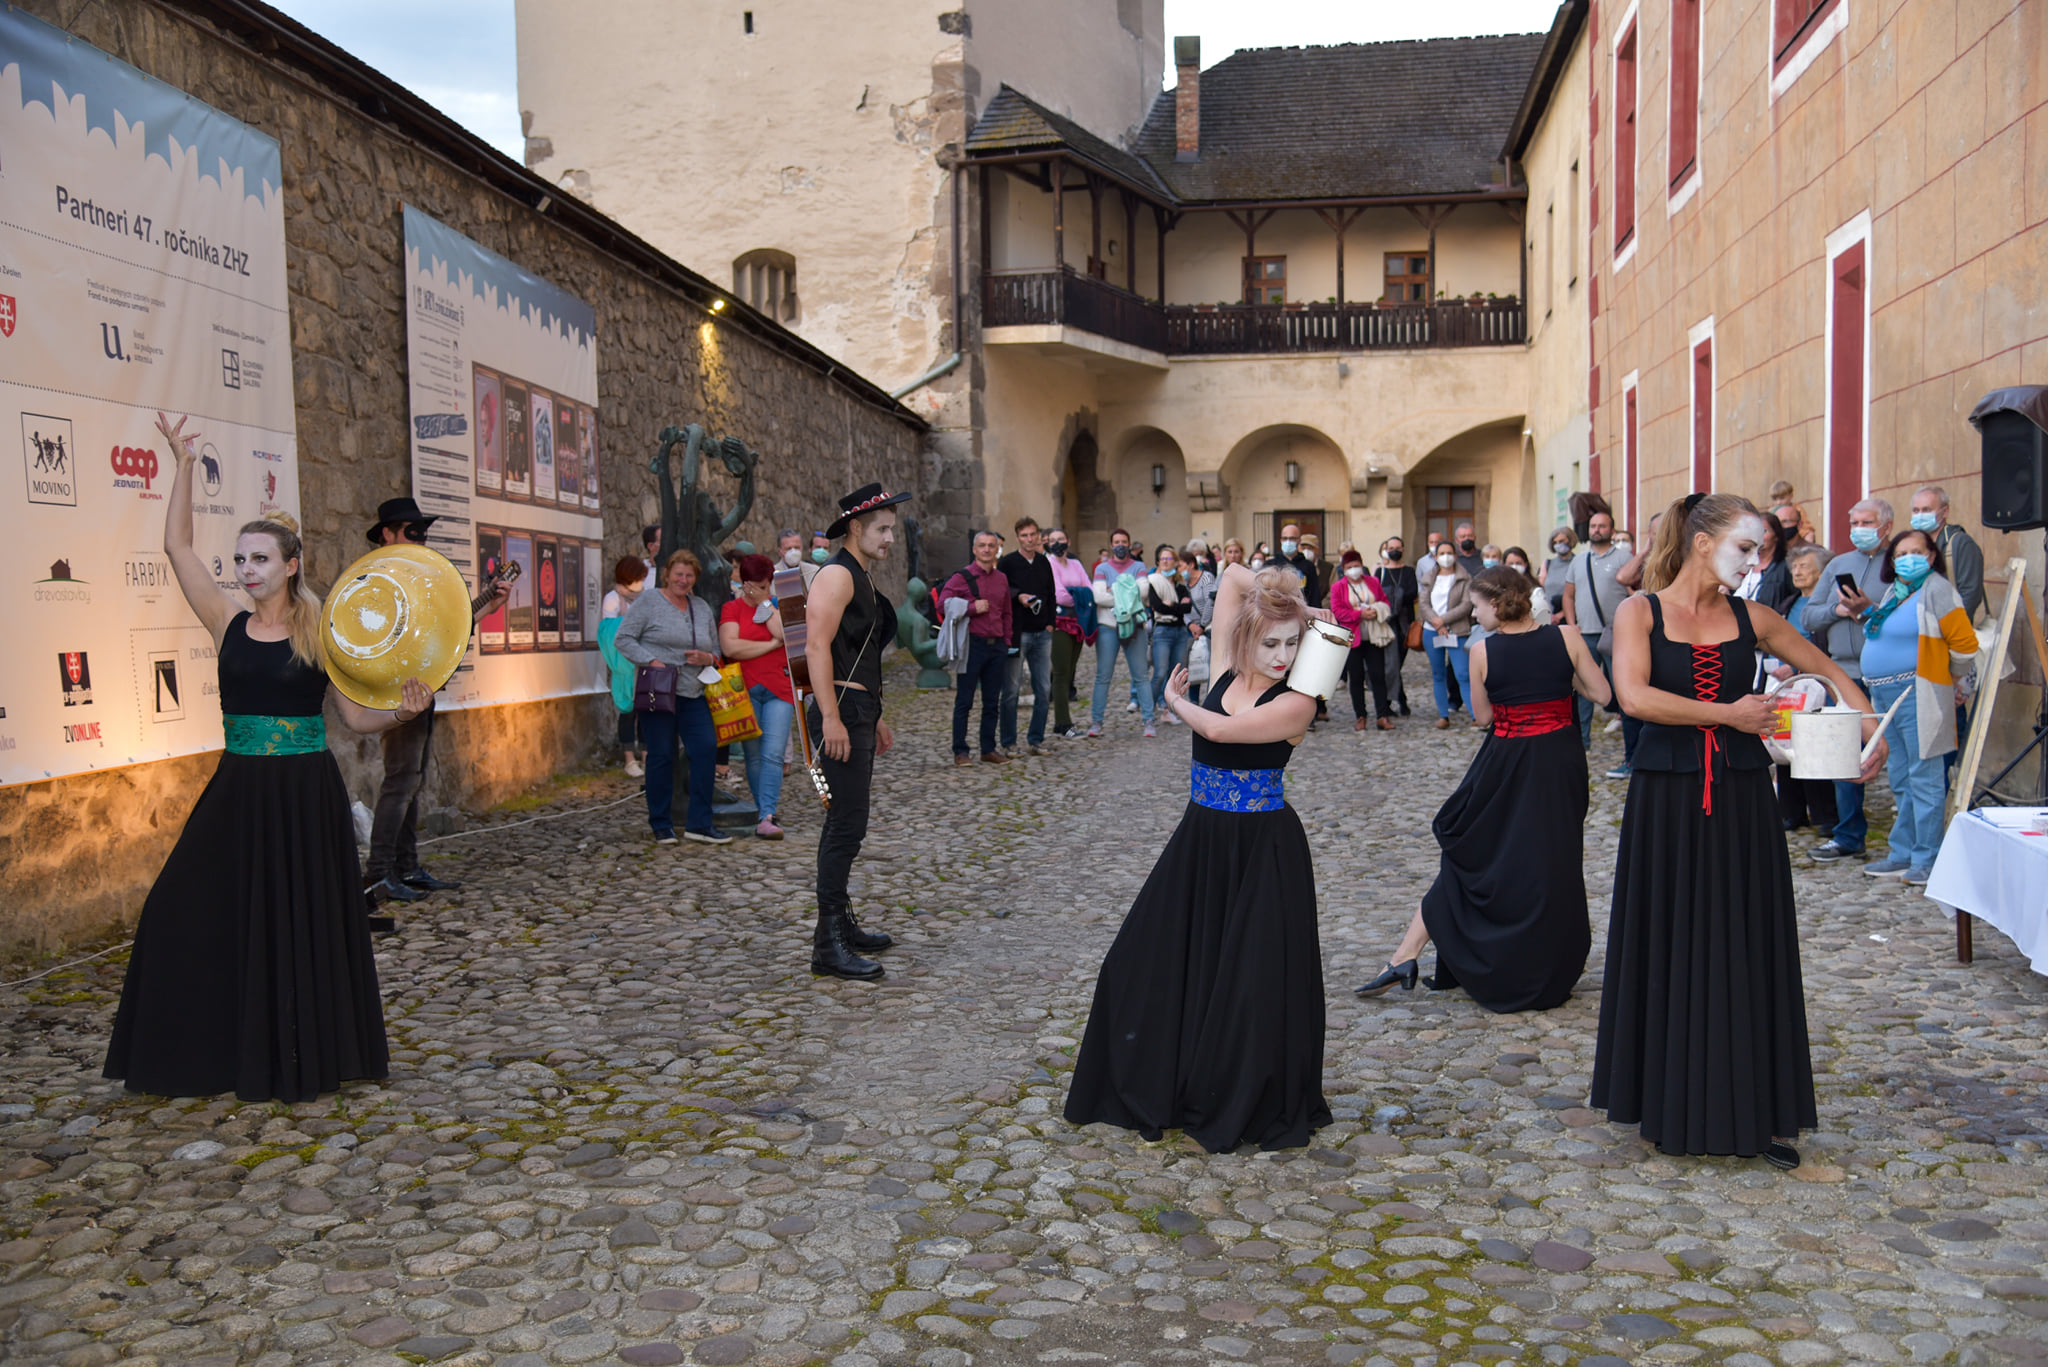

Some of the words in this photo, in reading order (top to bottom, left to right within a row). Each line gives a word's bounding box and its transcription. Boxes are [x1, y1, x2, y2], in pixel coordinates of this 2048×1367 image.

[55, 184, 129, 236] Partneri
[163, 228, 220, 266] ročníka
[222, 244, 251, 277] ZHZ
[32, 479, 71, 497] MOVINO
[113, 479, 144, 489] JEDNOTA
[124, 561, 170, 587] FARBYX
[33, 587, 91, 605] drevostavby
[63, 721, 102, 743] ZVONLINE
[718, 719, 754, 740] BILLA
